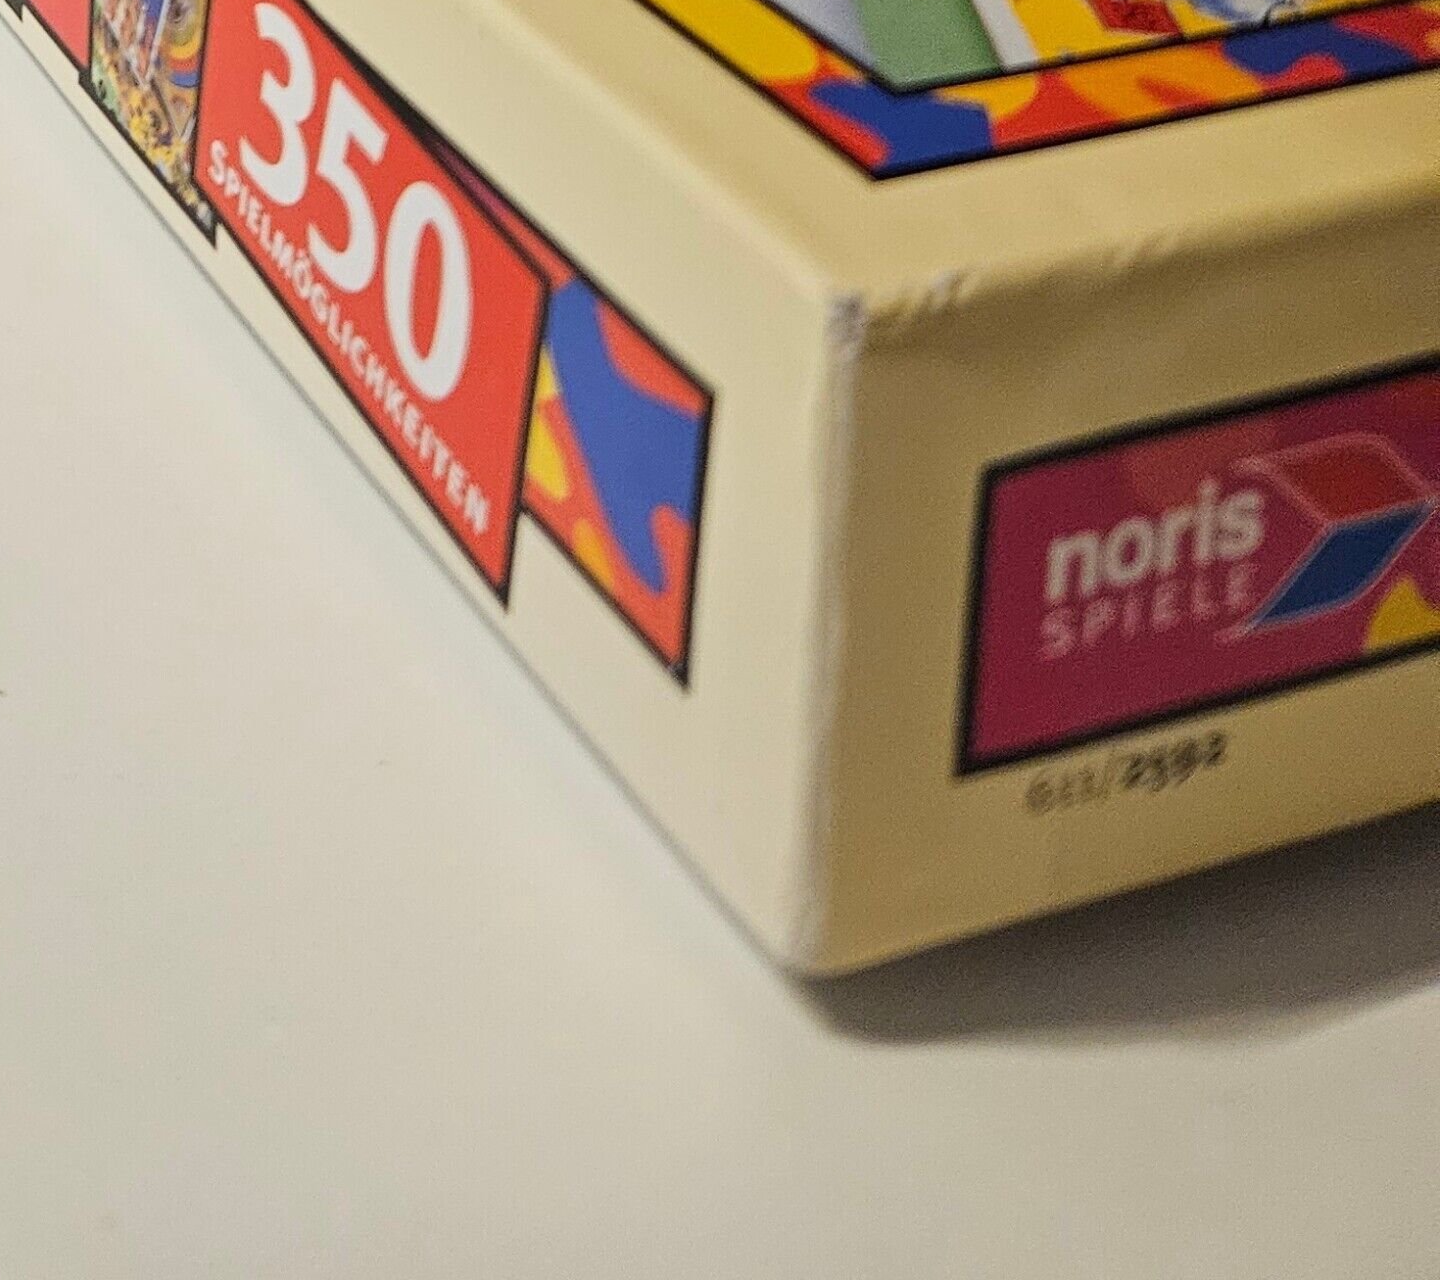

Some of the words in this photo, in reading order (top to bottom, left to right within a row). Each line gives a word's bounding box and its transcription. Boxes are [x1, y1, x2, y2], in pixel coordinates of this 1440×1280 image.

[239, 2, 473, 401] 350
[1044, 477, 1266, 603] noris
[1038, 564, 1261, 661] SPIELE
